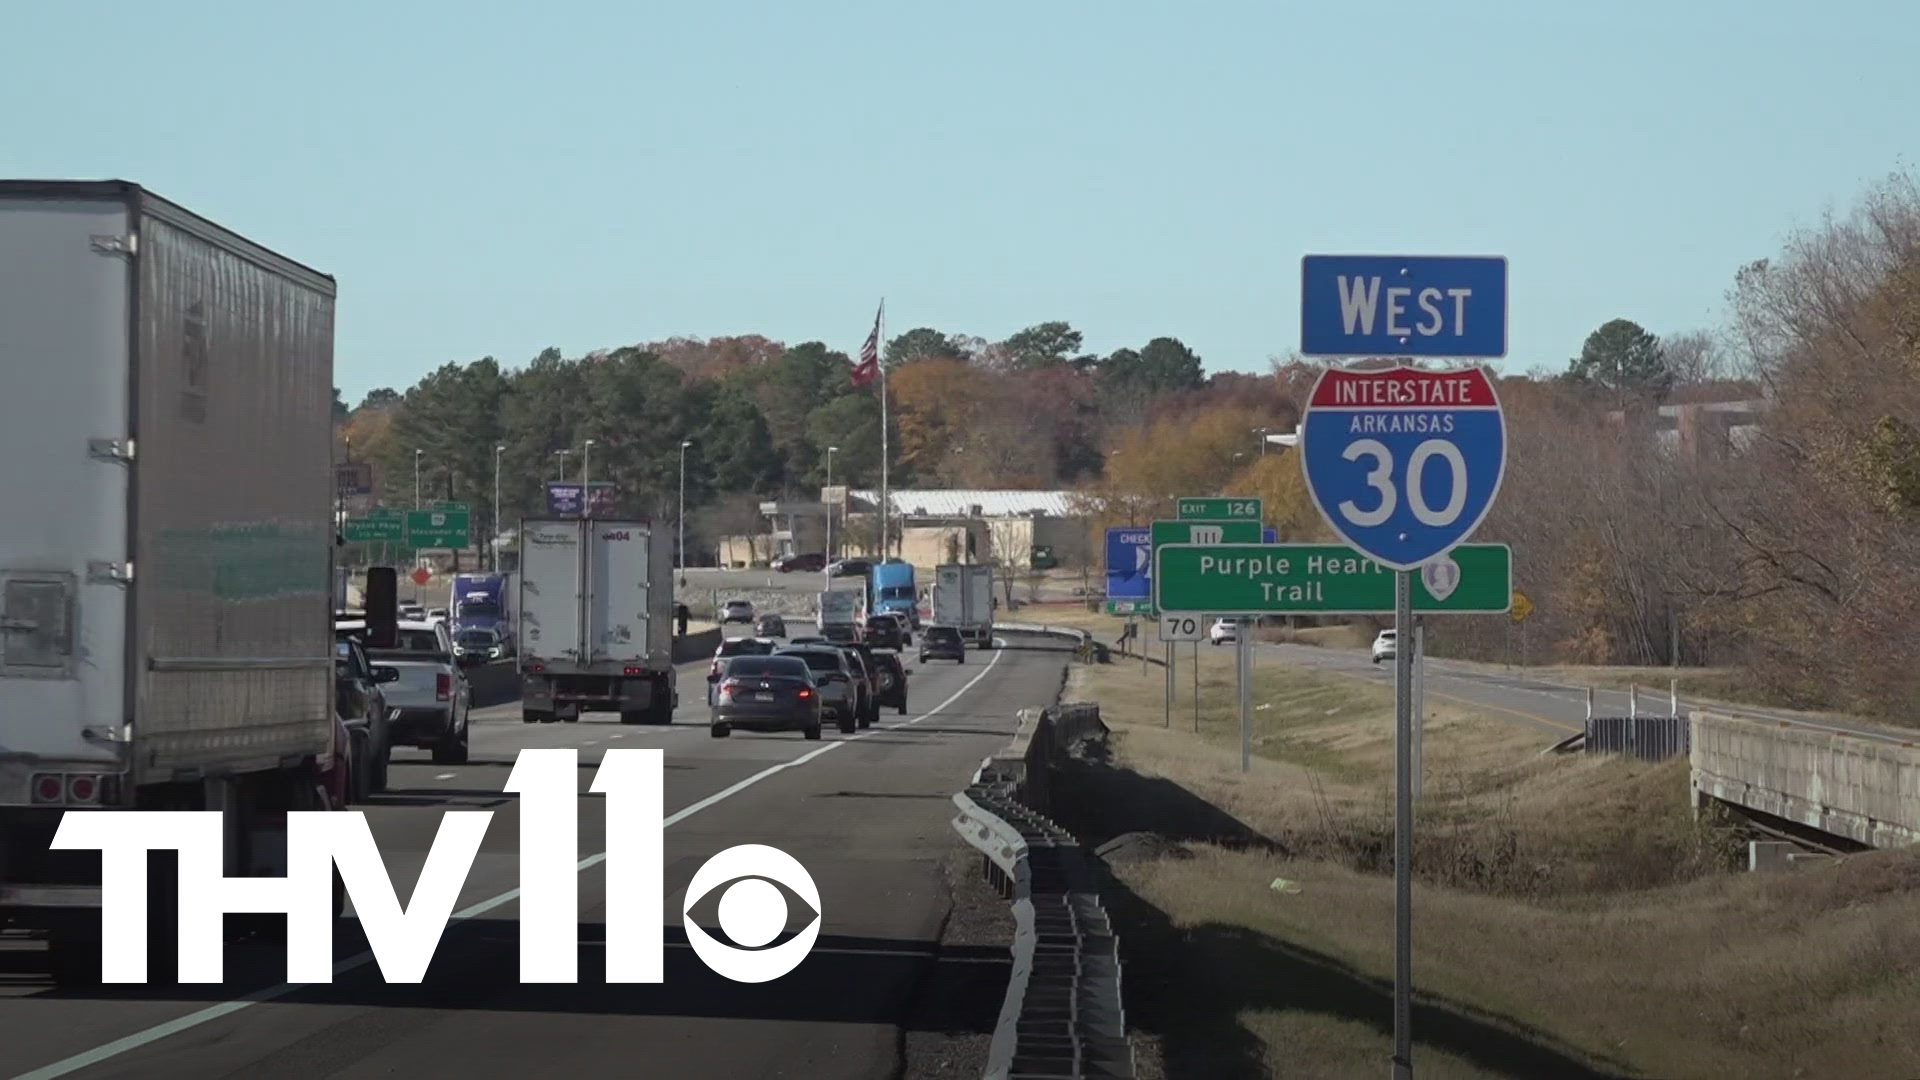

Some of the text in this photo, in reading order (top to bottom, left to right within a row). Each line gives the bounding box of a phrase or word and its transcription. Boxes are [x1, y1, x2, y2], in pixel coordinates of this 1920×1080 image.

[1337, 275, 1472, 337] WEST
[1335, 379, 1472, 403] INTERSTATE
[1350, 414, 1455, 433] ARKANSAS
[1338, 438, 1468, 527] 30
[1181, 502, 1256, 516] EXIT 126
[1201, 555, 1383, 579] Purple Heart
[1260, 581, 1324, 602] Trail
[1167, 618, 1196, 635] 70
